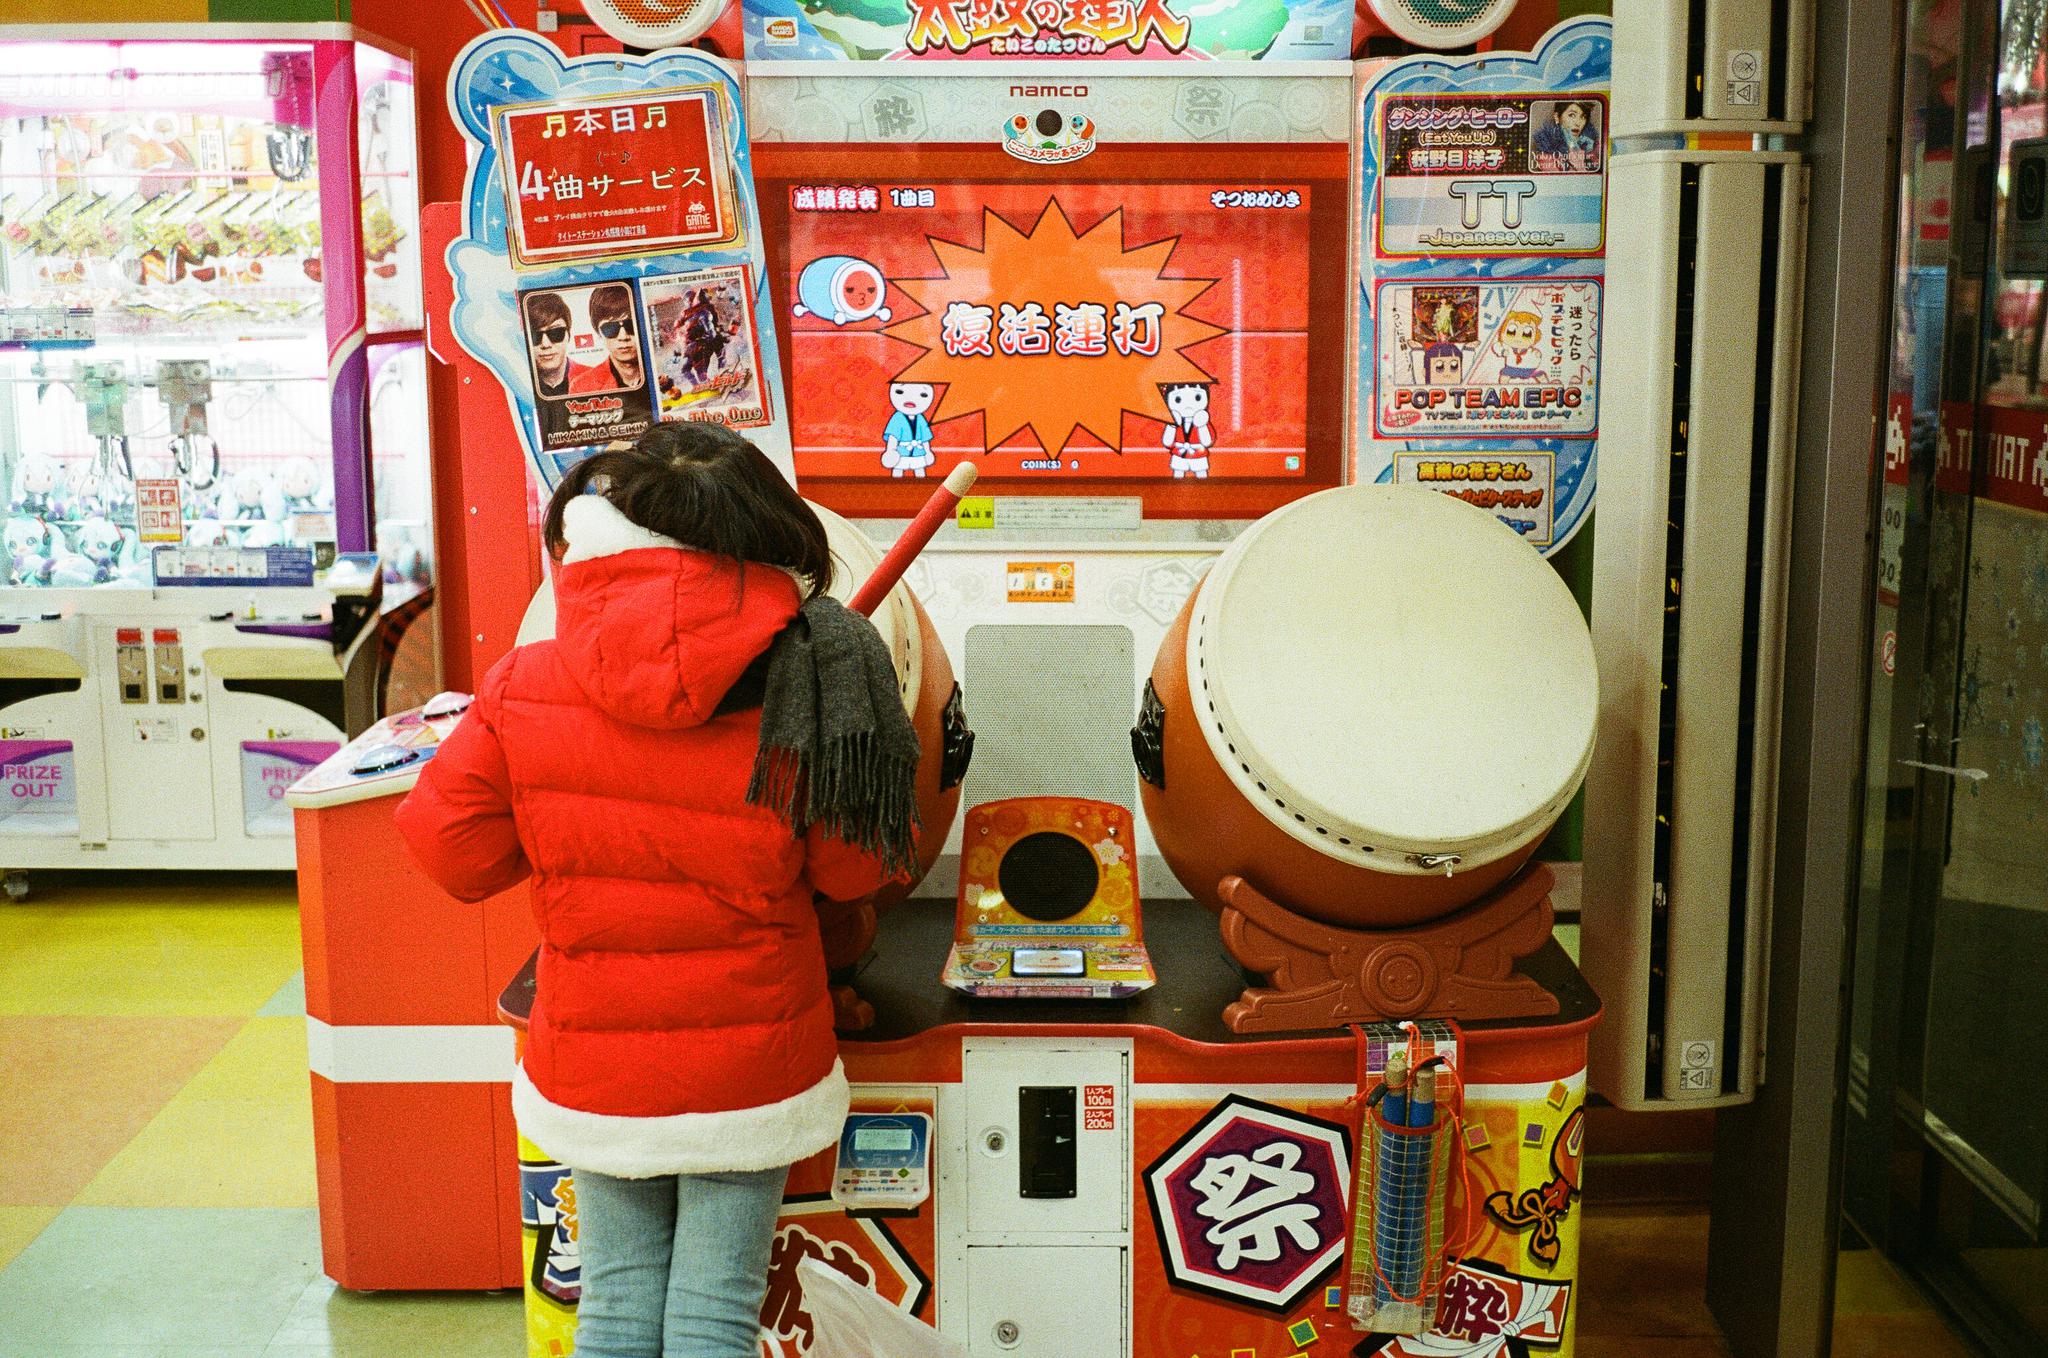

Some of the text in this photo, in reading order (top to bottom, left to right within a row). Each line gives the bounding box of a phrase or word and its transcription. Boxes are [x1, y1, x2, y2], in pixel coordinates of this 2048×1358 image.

[990, 36, 1106, 54] たいこのたつじん
[1009, 85, 1089, 98] namco
[573, 107, 635, 137] 本日
[1388, 107, 1528, 130] ダンシング・ヒーロー
[1418, 131, 1497, 146] (Eat You Up)
[794, 187, 937, 211] 成績発表 1曲目
[1448, 179, 1537, 229] TT
[941, 302, 1165, 357] 復活連打
[1568, 305, 1583, 361] 迷ったら
[565, 396, 624, 414] YouTube
[1394, 387, 1582, 409] POP TEAM EPIC
[568, 409, 624, 428] テーマソング
[727, 406, 763, 421] One
[548, 421, 649, 445] HIKAKIN & SEIKIN
[1021, 459, 1062, 470] COIN(S)
[4, 764, 63, 780] PRIZE
[11, 783, 57, 798] OUT
[1087, 1095, 1112, 1106] 100円
[1086, 1118, 1112, 1129] 200円
[1189, 1140, 1322, 1271] 祭
